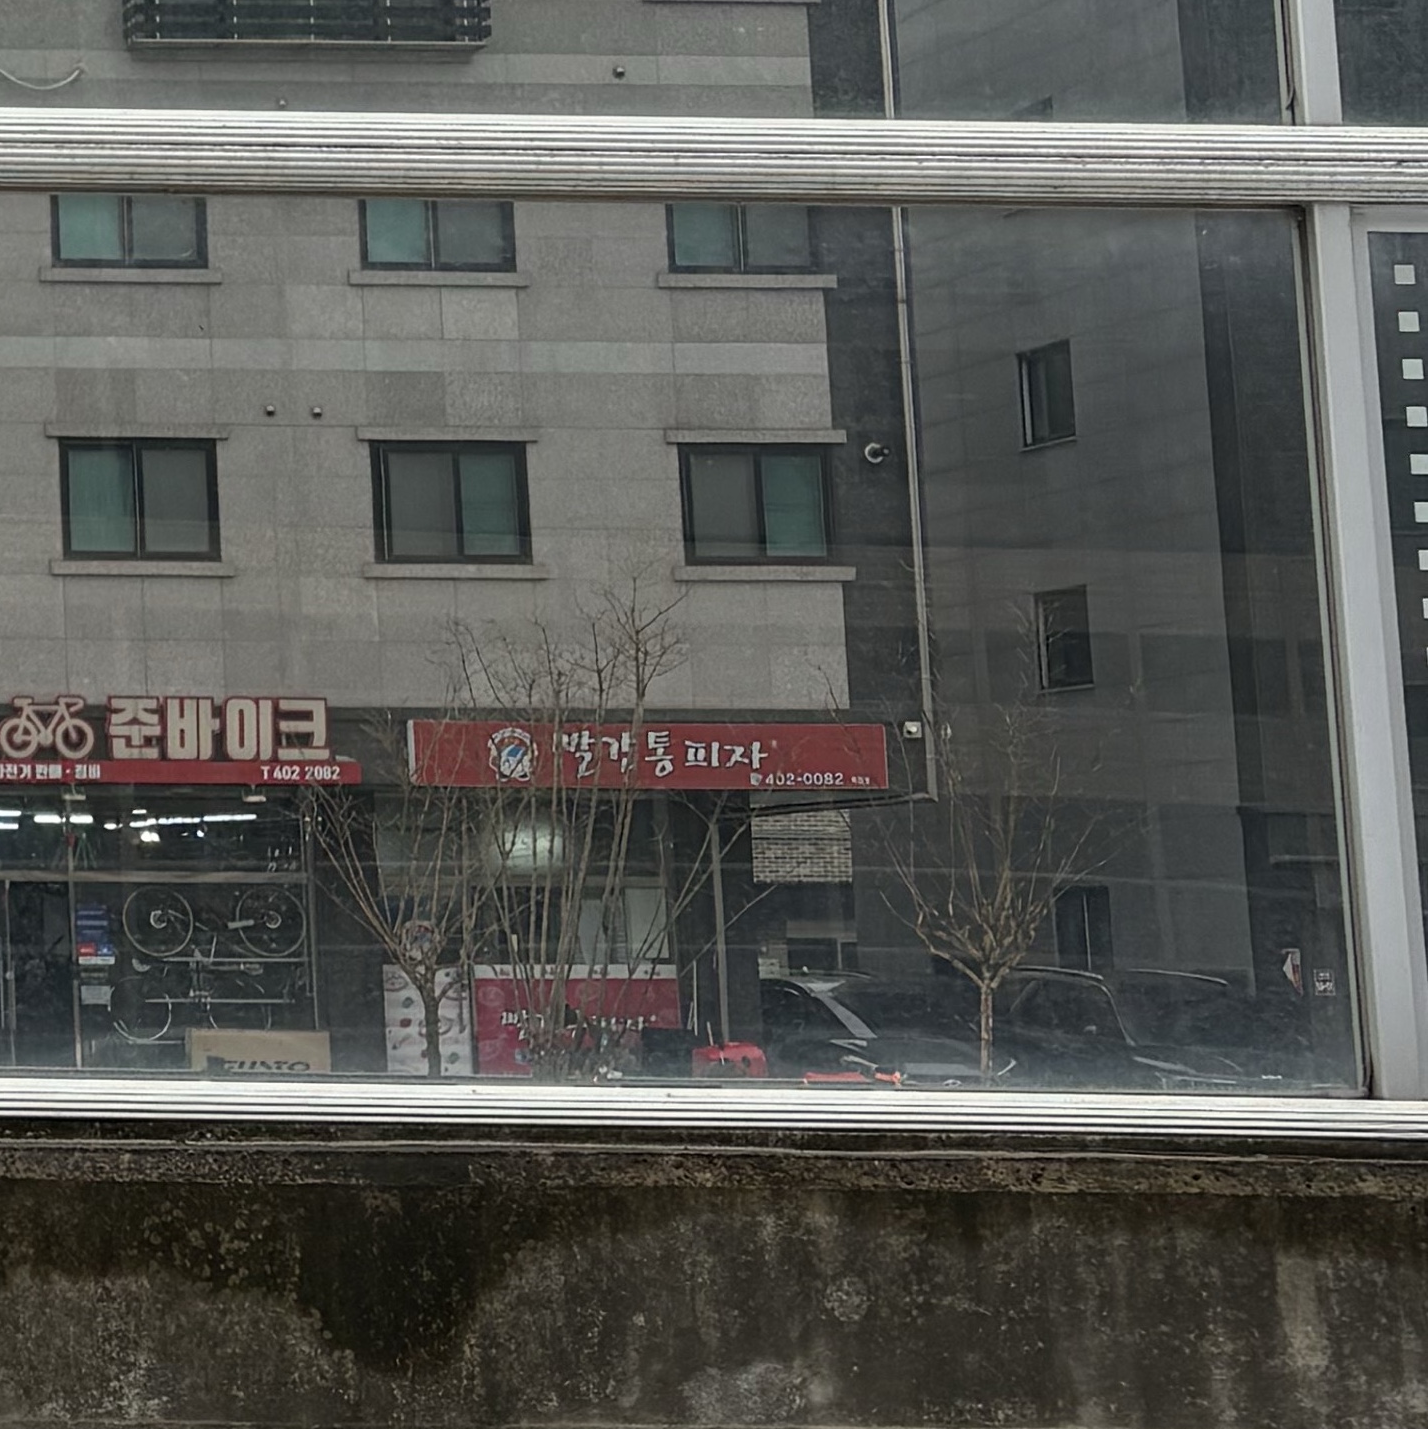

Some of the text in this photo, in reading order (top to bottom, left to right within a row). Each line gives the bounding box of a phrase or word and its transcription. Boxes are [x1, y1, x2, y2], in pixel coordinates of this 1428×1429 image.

[108, 696, 331, 760] 준바이크
[273, 765, 301, 780] 402
[304, 765, 341, 780] 2082
[764, 772, 845, 786] 402-0082
